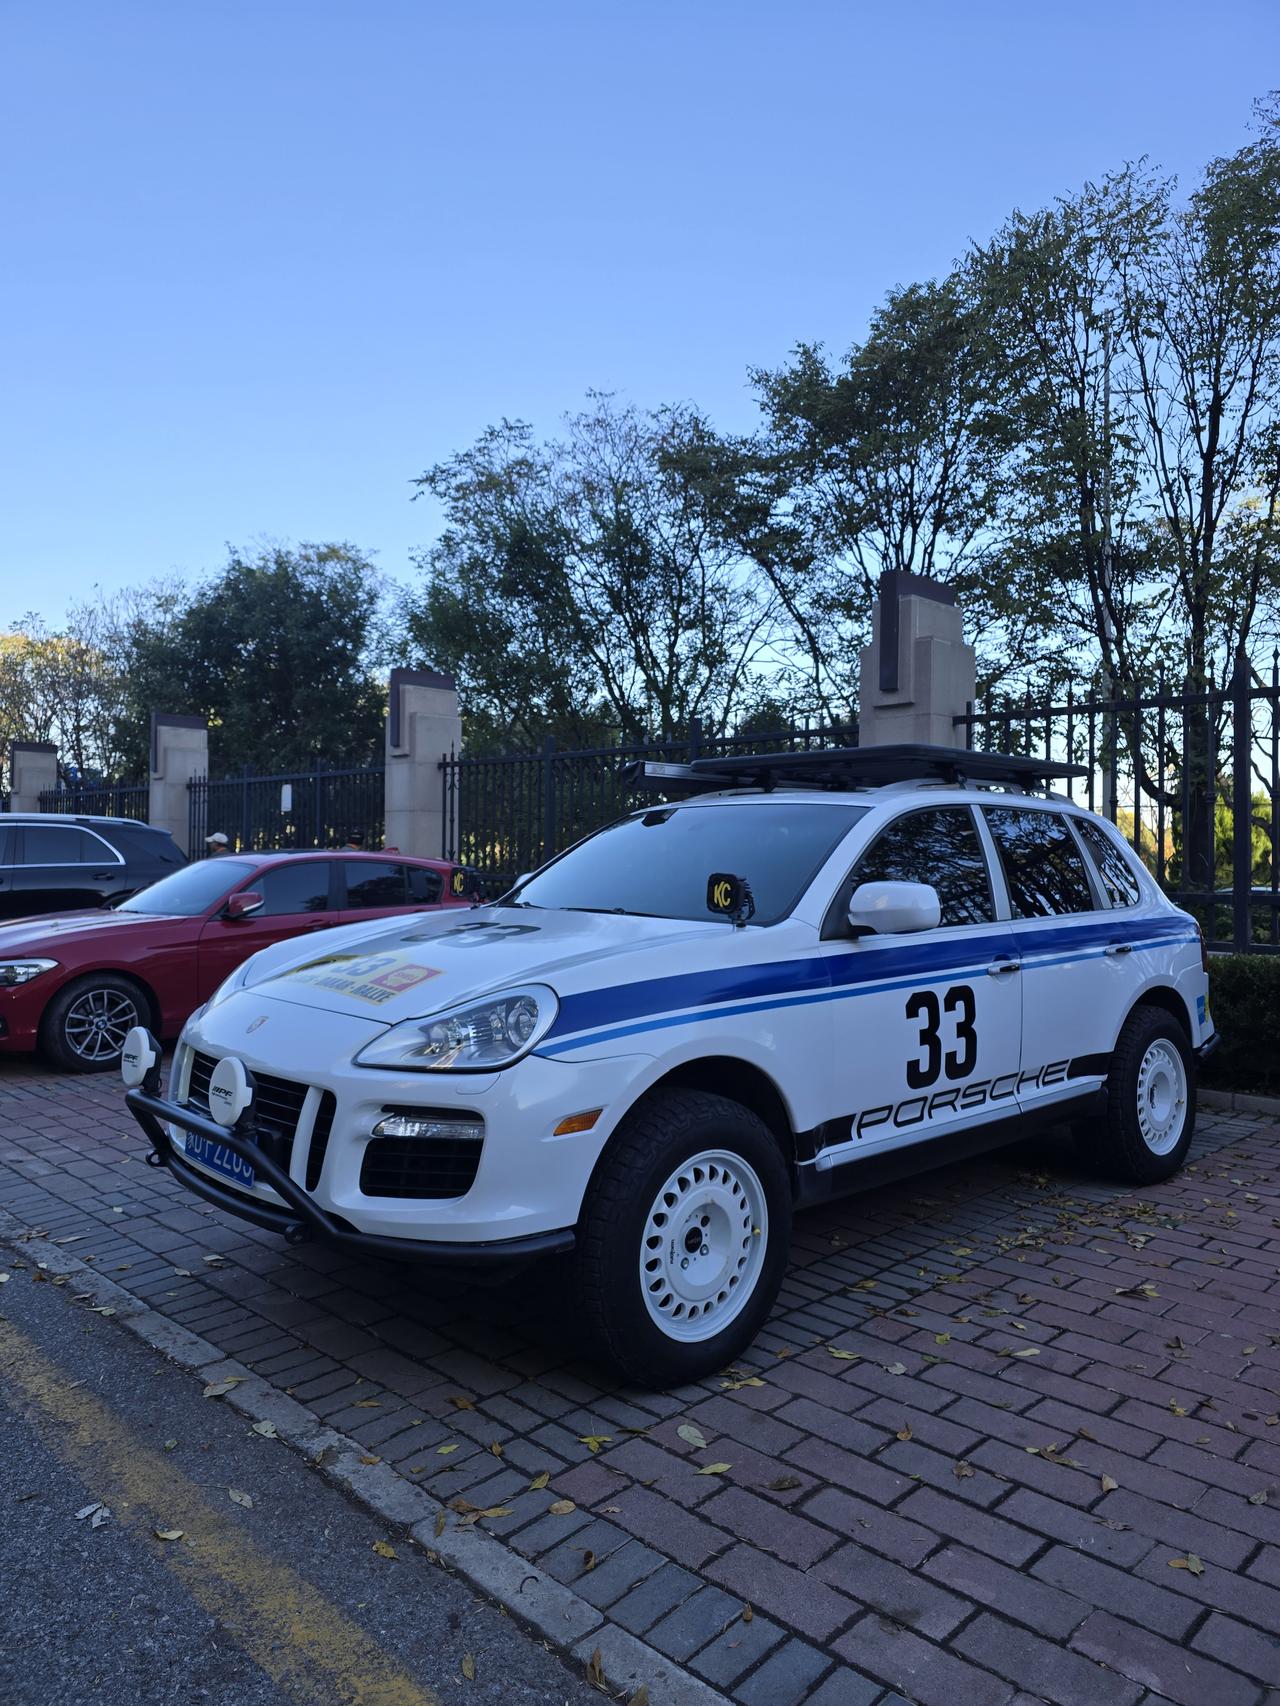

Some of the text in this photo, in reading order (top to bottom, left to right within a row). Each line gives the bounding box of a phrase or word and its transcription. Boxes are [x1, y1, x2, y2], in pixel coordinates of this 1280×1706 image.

[453, 872, 464, 894] KC
[714, 881, 731, 907] KC
[400, 921, 542, 948] 33
[905, 984, 978, 1090] 33
[855, 1059, 1070, 1139] PORSCHE
